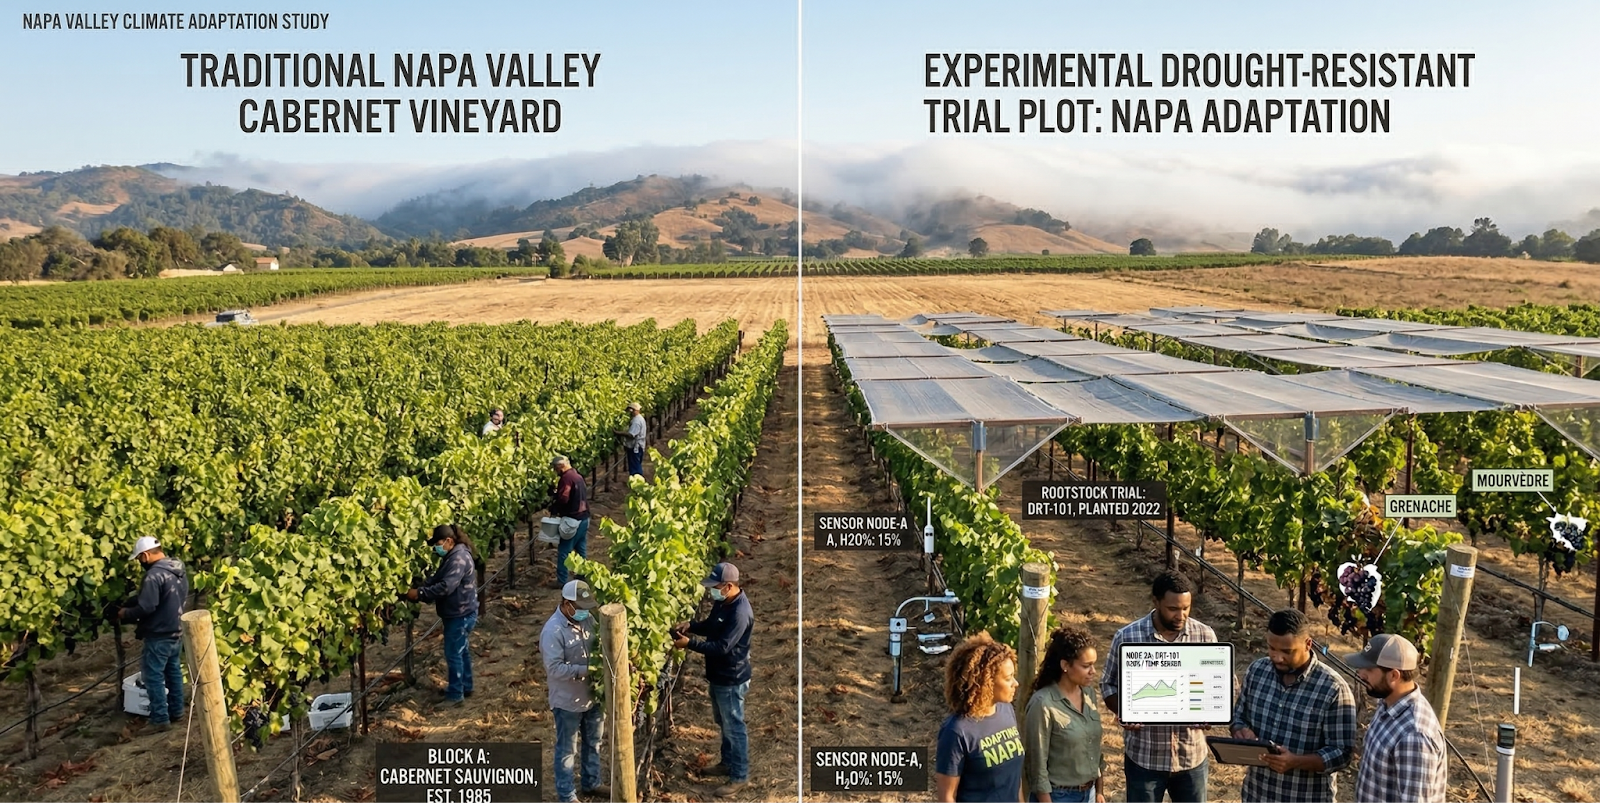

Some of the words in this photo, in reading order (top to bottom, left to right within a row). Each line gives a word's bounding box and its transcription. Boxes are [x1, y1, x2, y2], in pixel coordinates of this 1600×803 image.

[1126, 651, 1143, 660] NODE
[980, 726, 1020, 751] ADAPTING
[983, 737, 1026, 768] NAPA
